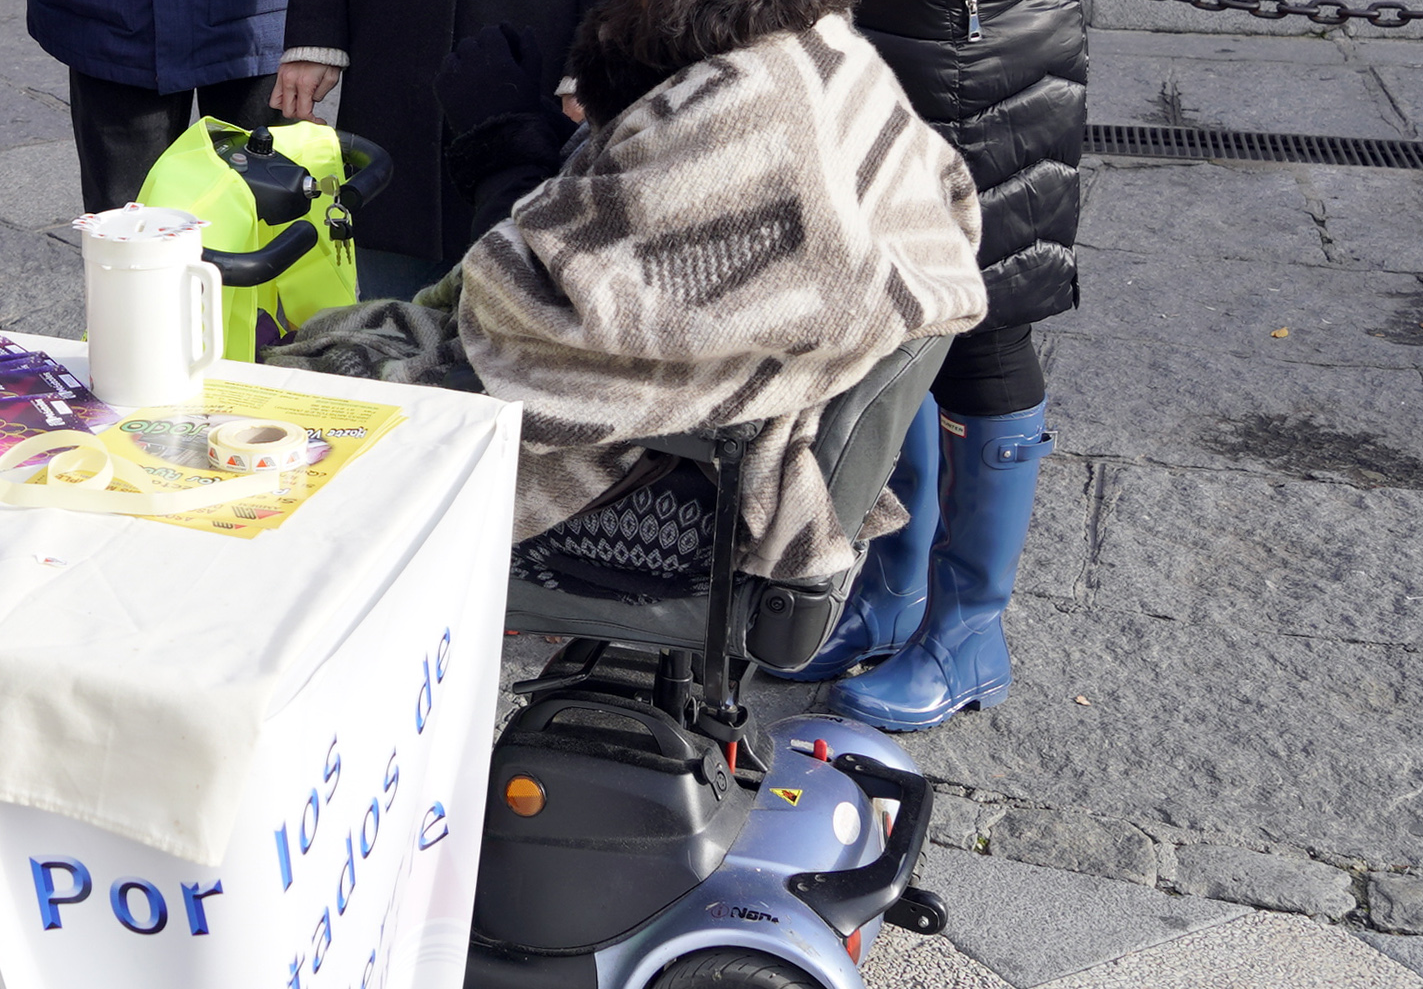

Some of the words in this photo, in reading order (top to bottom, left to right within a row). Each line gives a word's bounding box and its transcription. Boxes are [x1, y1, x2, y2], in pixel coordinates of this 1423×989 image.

[29, 854, 224, 937] Por
[273, 732, 342, 893] los
[286, 745, 399, 989] tados
[415, 625, 451, 736] de
